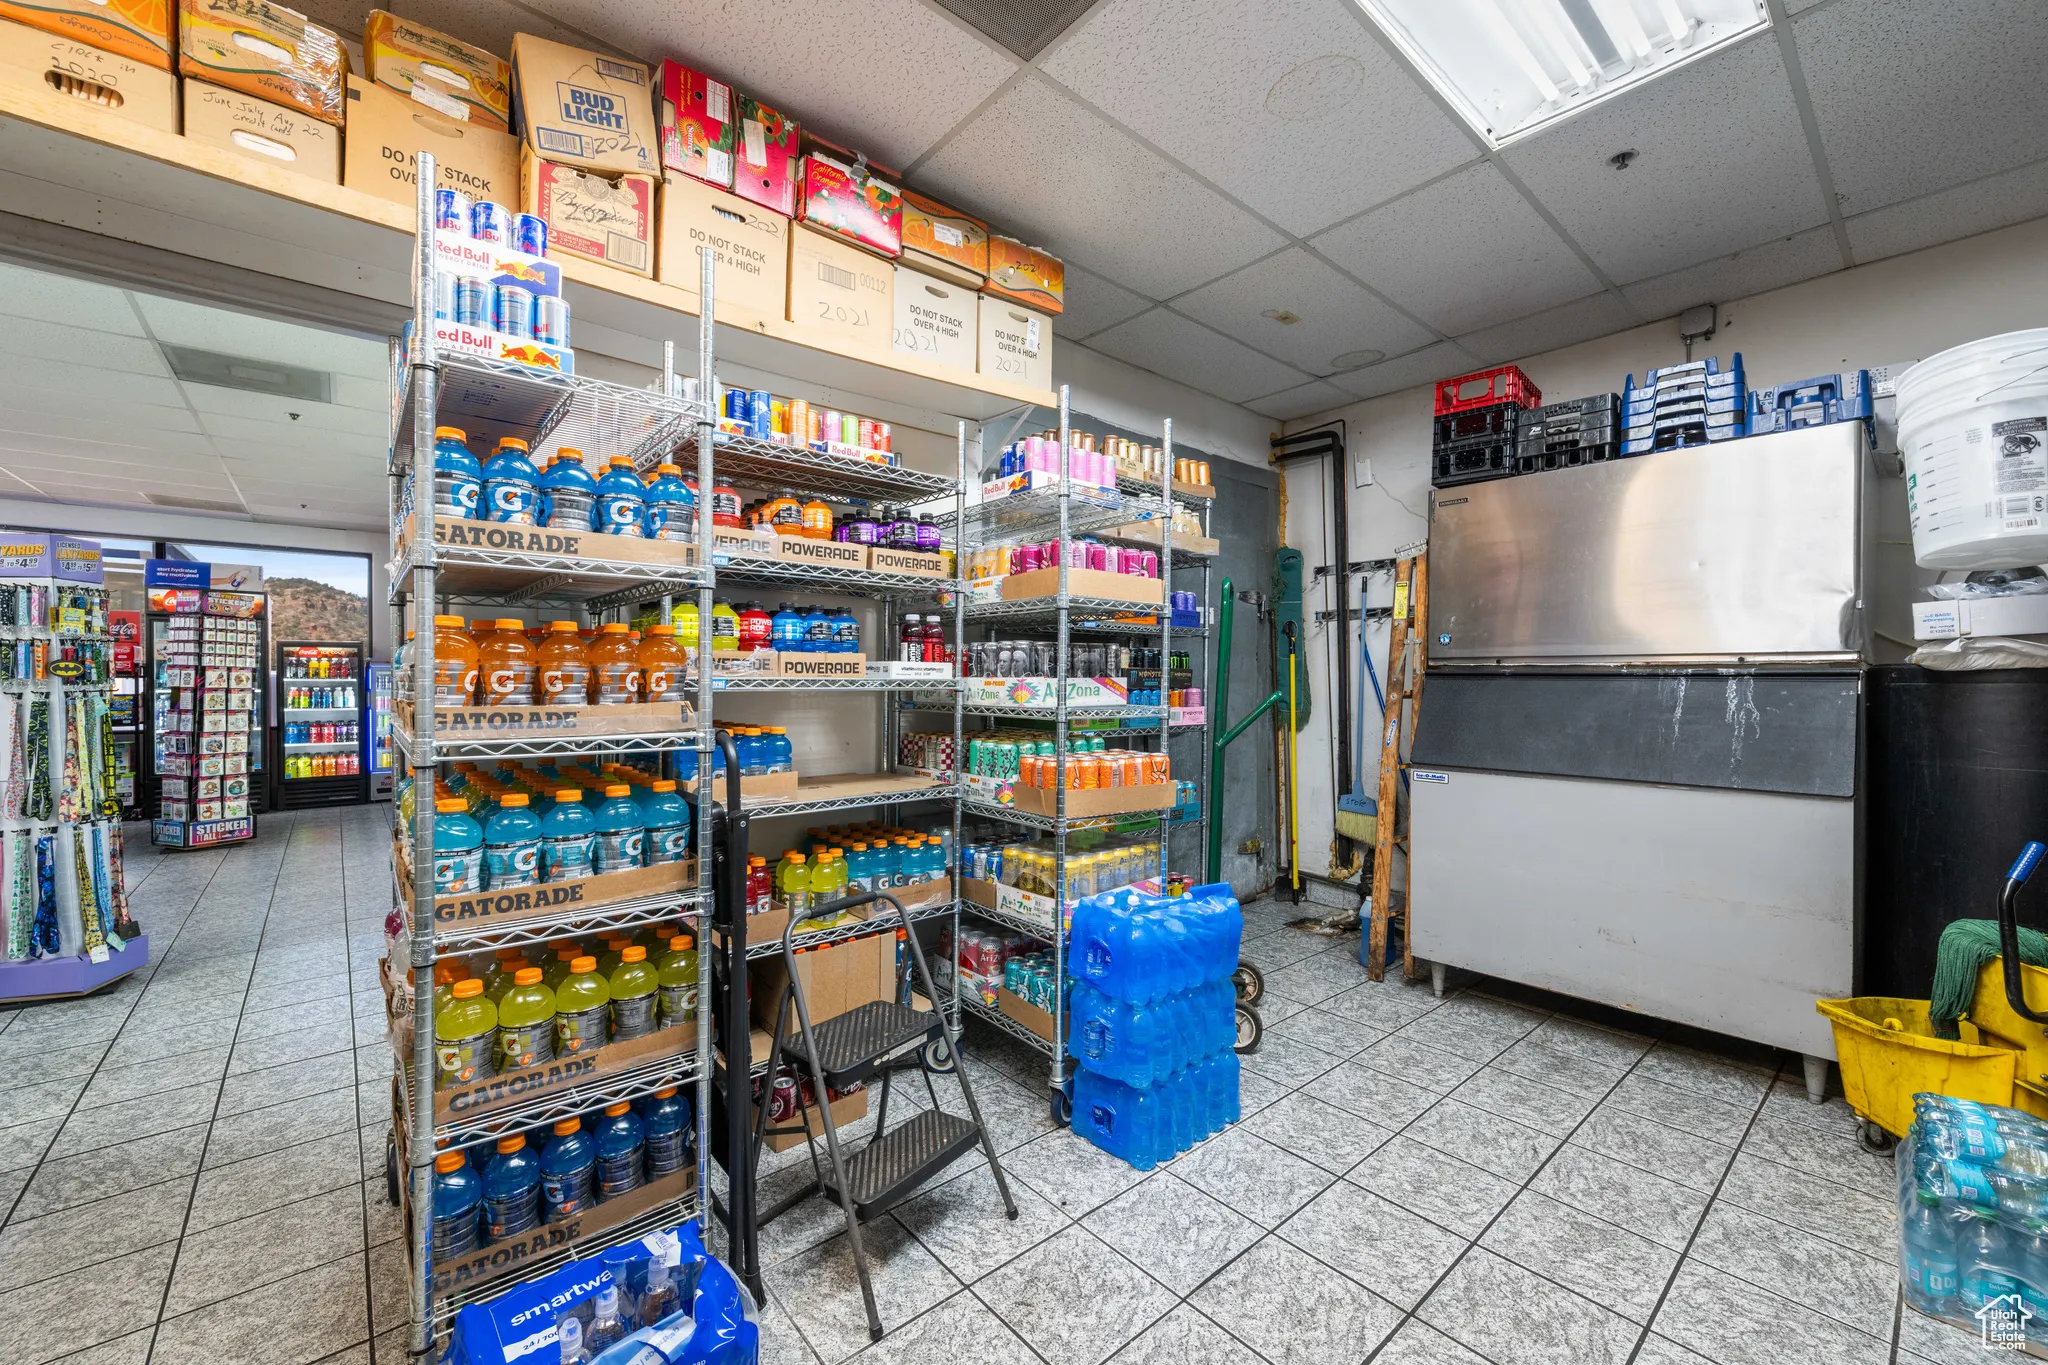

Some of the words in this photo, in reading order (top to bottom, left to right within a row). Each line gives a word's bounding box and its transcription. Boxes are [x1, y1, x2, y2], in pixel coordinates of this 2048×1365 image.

[51, 55, 118, 87] 2020
[570, 88, 615, 112] BUD
[203, 91, 232, 110] June
[237, 101, 264, 119] July
[303, 126, 324, 139] 22
[563, 102, 624, 130] LIGHT
[637, 146, 648, 161] 4
[382, 146, 405, 164] DO
[444, 162, 492, 193] STACK
[390, 166, 417, 186] OVE
[811, 162, 847, 183] California
[811, 171, 841, 190] Oranges
[542, 180, 551, 221] ENUINE
[435, 239, 462, 257] Red
[463, 247, 490, 265] Bull
[689, 227, 706, 242] DO
[708, 234, 731, 250] NOT
[733, 242, 767, 264] STACK
[438, 252, 465, 264] NERGY
[695, 245, 724, 263] OER
[727, 256, 733, 266] 4
[735, 258, 761, 276] HIGH
[860, 272, 886, 295] 00112
[818, 301, 870, 328] 2021
[910, 304, 921, 315] DO
[922, 308, 938, 322] NOT
[939, 314, 963, 329] STACK
[435, 328, 459, 342] ed
[461, 330, 492, 350] Bull
[913, 317, 934, 332] OVER
[935, 323, 941, 333] 4
[941, 325, 959, 340] HIGH
[437, 341, 493, 357] GARFREE
[995, 329, 1006, 339] DO
[1006, 333, 1020, 344] NOT
[1021, 337, 1041, 351] STK
[998, 341, 1017, 355] OVER
[1017, 347, 1022, 356] 4
[1022, 349, 1038, 360] HIGH
[995, 355, 1028, 380] 2021
[2000, 426, 2046, 437] AVERTISSEMENT
[2004, 422, 2042, 431] ADVERTENCIA
[831, 444, 846, 455] Red
[846, 448, 861, 458] Bull
[495, 485, 523, 511] G
[983, 486, 993, 496] Red
[993, 482, 1006, 494] Bull
[611, 501, 634, 524] G
[434, 523, 580, 555] GATORADE
[56, 549, 101, 561] LANYARDS
[782, 541, 860, 562] POWERADE
[876, 553, 943, 572] POWERADE
[169, 571, 200, 579] motivated
[784, 661, 860, 674] POWERADE
[491, 671, 515, 692] G
[543, 671, 565, 692] G
[651, 671, 668, 692] G
[1042, 681, 1101, 703] ArZona
[966, 687, 1000, 702] AriZona
[434, 711, 578, 732] GATORADE
[1415, 772, 1447, 781] Ice-O-Matic
[155, 824, 181, 837] STICKER
[195, 819, 248, 836] STICKER
[203, 832, 217, 841] ALL
[664, 831, 686, 853] G
[513, 846, 537, 871] G
[434, 859, 455, 883] G
[877, 876, 889, 889] G
[434, 882, 584, 923] GATORADE
[502, 1033, 522, 1056] G
[437, 1047, 462, 1071] G
[449, 1055, 597, 1113] GATORADE
[433, 1221, 582, 1291] GATORADE
[510, 1269, 614, 1328] smartwa
[522, 1339, 535, 1351] 24
